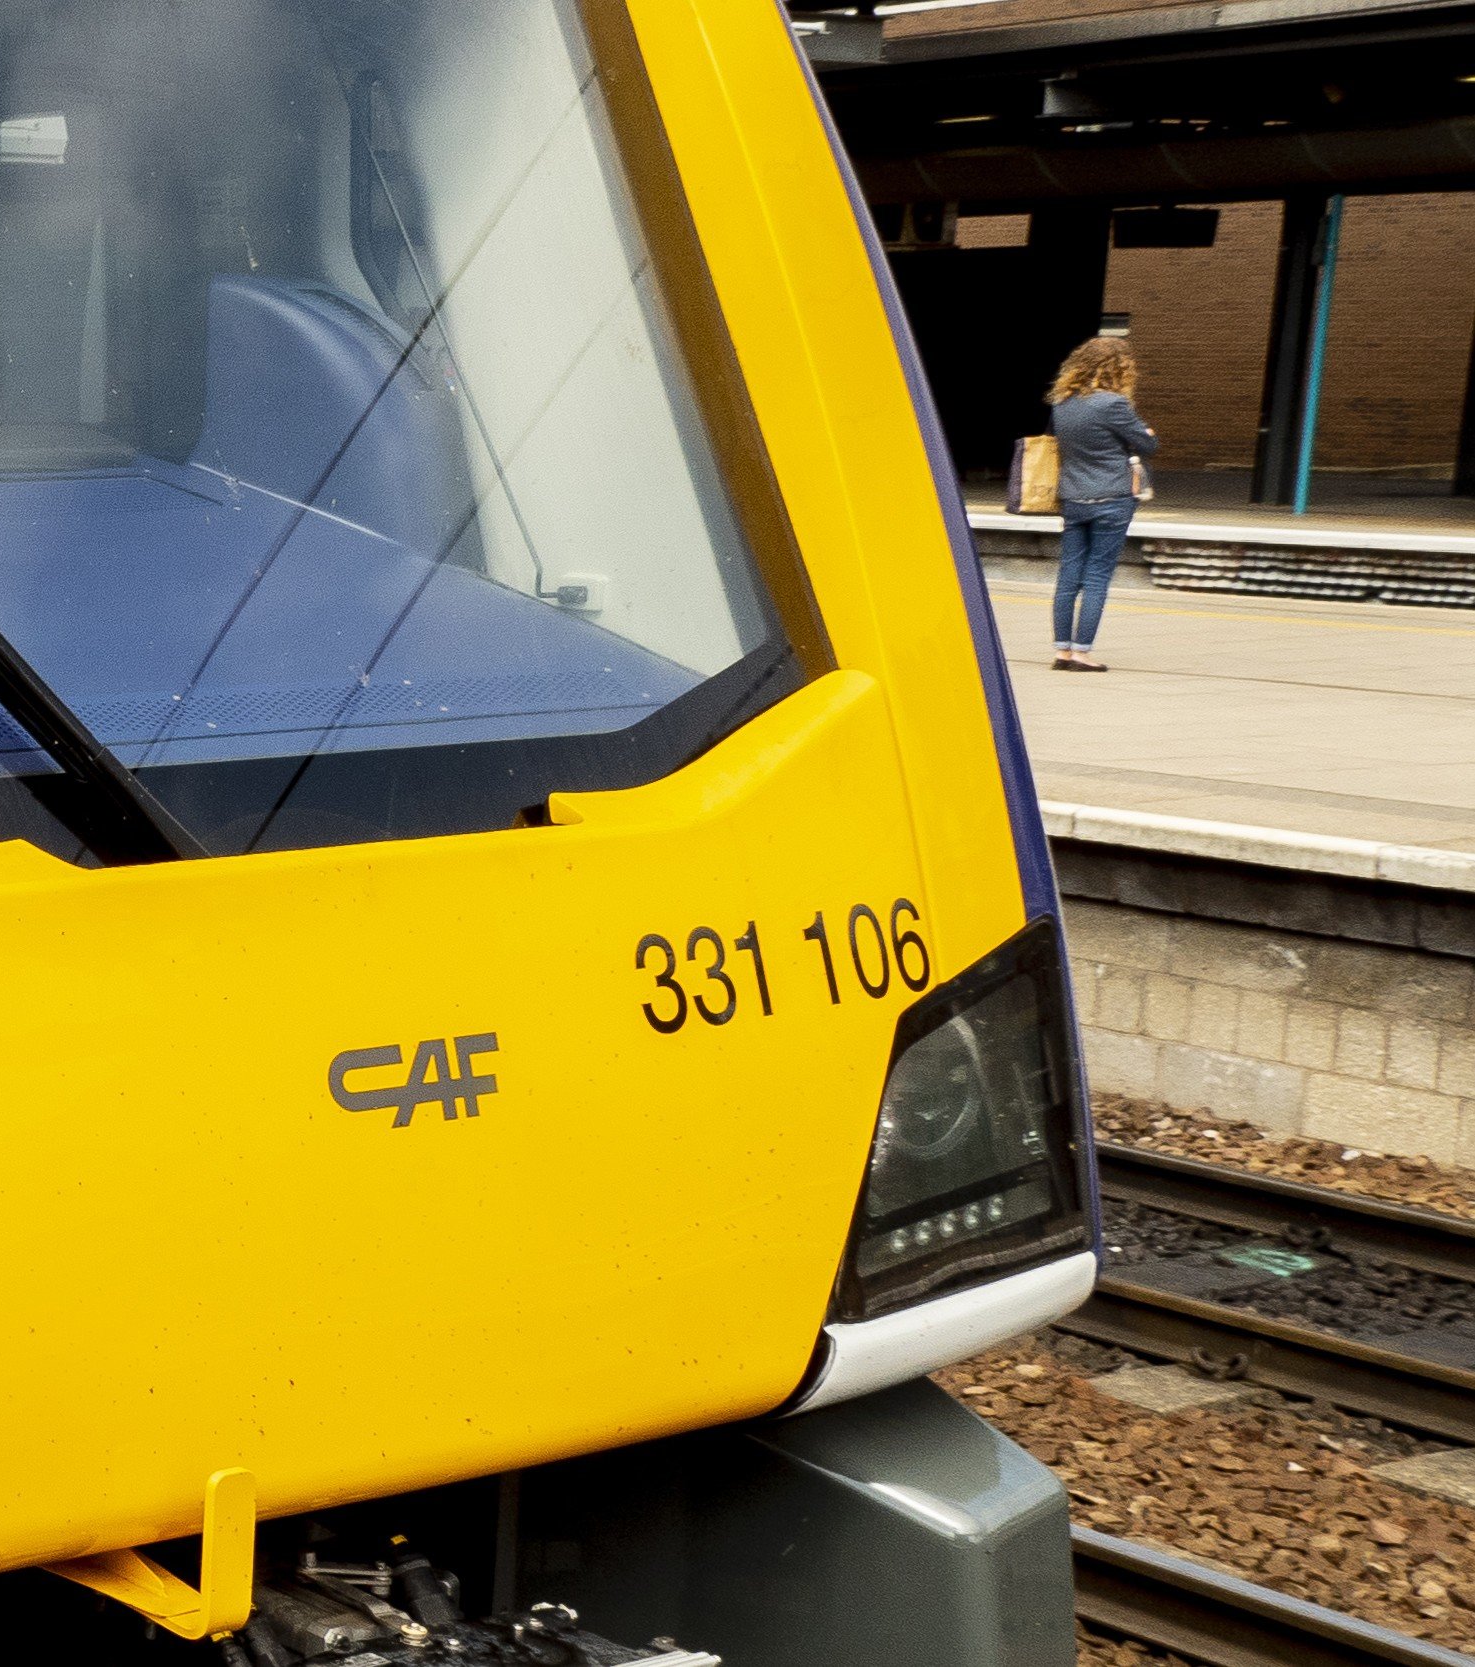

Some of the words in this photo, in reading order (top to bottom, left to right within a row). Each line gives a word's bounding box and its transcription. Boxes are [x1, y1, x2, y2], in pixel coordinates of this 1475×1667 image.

[635, 920, 774, 1035] 331
[802, 897, 932, 1005] 106
[327, 1031, 500, 1129] CAF
